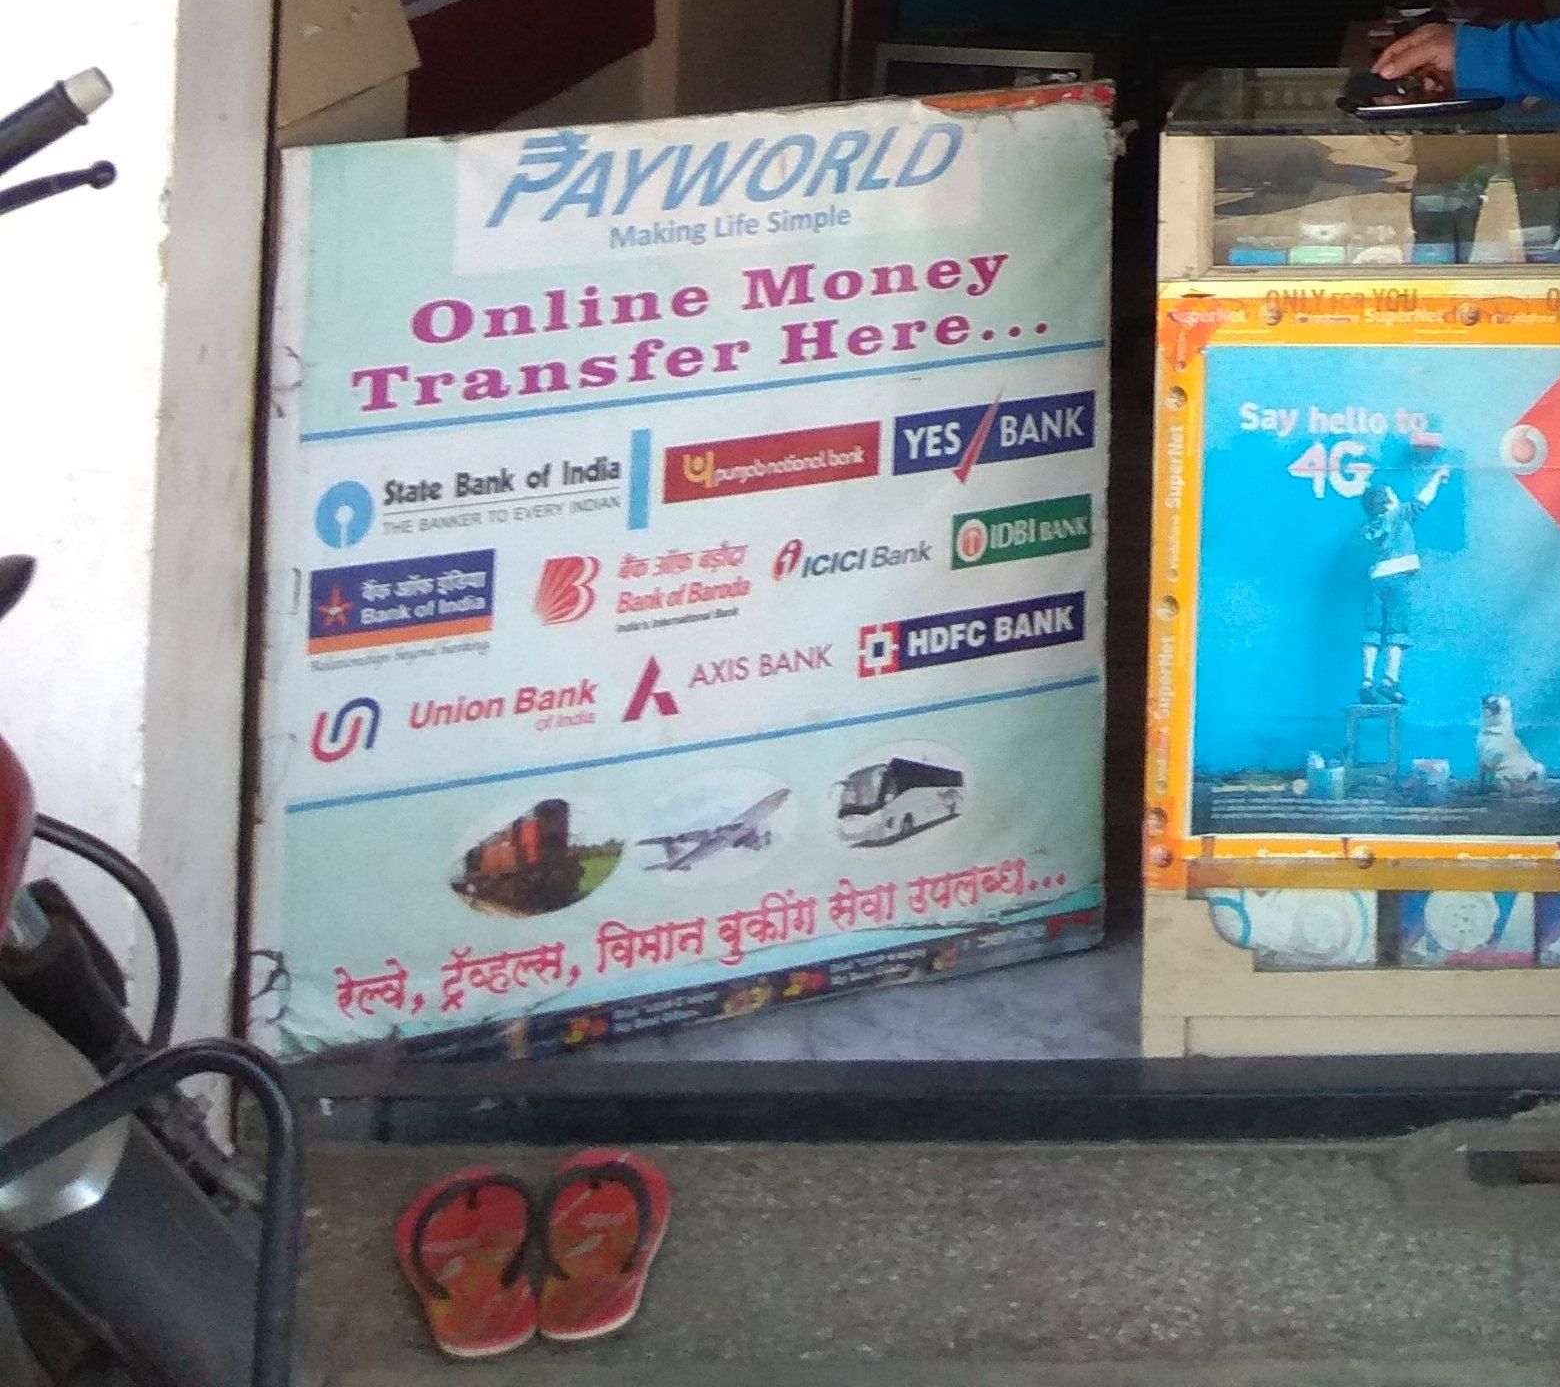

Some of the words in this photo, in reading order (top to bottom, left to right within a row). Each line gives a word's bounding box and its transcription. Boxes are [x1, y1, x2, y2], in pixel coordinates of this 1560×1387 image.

[486, 121, 968, 229] PAYWORLD
[608, 216, 708, 252] Making
[711, 210, 761, 242] Life
[766, 202, 852, 240] Simple
[409, 282, 711, 346] Online
[740, 251, 1010, 316] Money
[1266, 288, 1326, 313] ONLY
[1371, 287, 1420, 313] YOU
[350, 337, 751, 414] Transfer
[778, 310, 1050, 366] Here...
[903, 421, 963, 460] YES
[999, 404, 1087, 449] BANK
[1239, 402, 1297, 438] Say
[1308, 402, 1384, 434] hello
[1391, 407, 1428, 436] to
[828, 444, 866, 468] bank
[1288, 439, 1372, 499] 4G
[383, 479, 443, 506] State
[453, 467, 516, 498] Bank
[524, 462, 552, 489] of
[561, 455, 623, 486] India
[383, 519, 414, 535] THE
[418, 511, 483, 532] BANKER
[488, 507, 509, 524] TO
[512, 501, 564, 522] EVERY
[568, 495, 622, 516] INDIAN
[989, 518, 1035, 551] IDBI
[1039, 515, 1089, 542] BANK
[802, 548, 867, 578] ICICI
[870, 539, 934, 569] Bank
[360, 604, 411, 625] Bank
[416, 600, 435, 618] of
[437, 594, 487, 615] India
[616, 588, 666, 614] Bank
[667, 584, 687, 608] of
[687, 577, 752, 604] Baroda
[906, 624, 987, 658] HDFC
[994, 604, 1077, 643] BANK
[688, 657, 751, 689] AXIS
[757, 643, 834, 678] BANK
[408, 696, 504, 730] Union
[512, 678, 599, 717] Bank
[554, 709, 598, 727] India
[597, 915, 706, 974] विमान
[715, 888, 818, 966] बुकींग
[828, 876, 897, 932] सेवा
